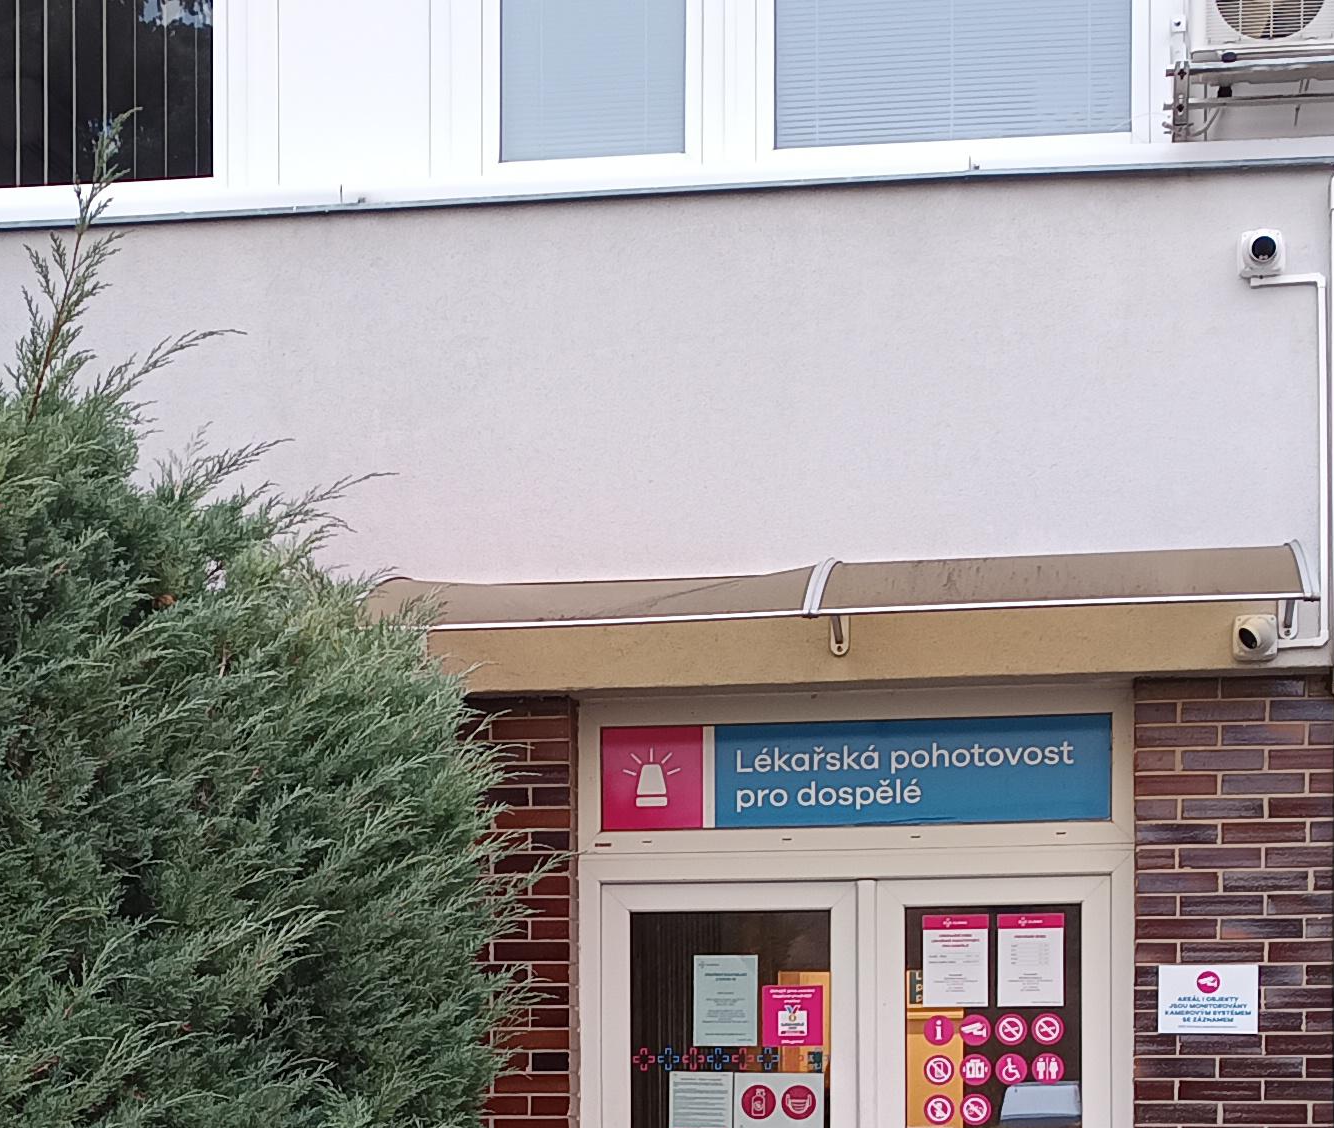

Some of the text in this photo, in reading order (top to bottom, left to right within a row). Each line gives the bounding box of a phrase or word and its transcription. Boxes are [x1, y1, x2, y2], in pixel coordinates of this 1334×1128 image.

[736, 741, 1075, 774] Lékařská pohotovost
[735, 779, 922, 812] pro dospělé
